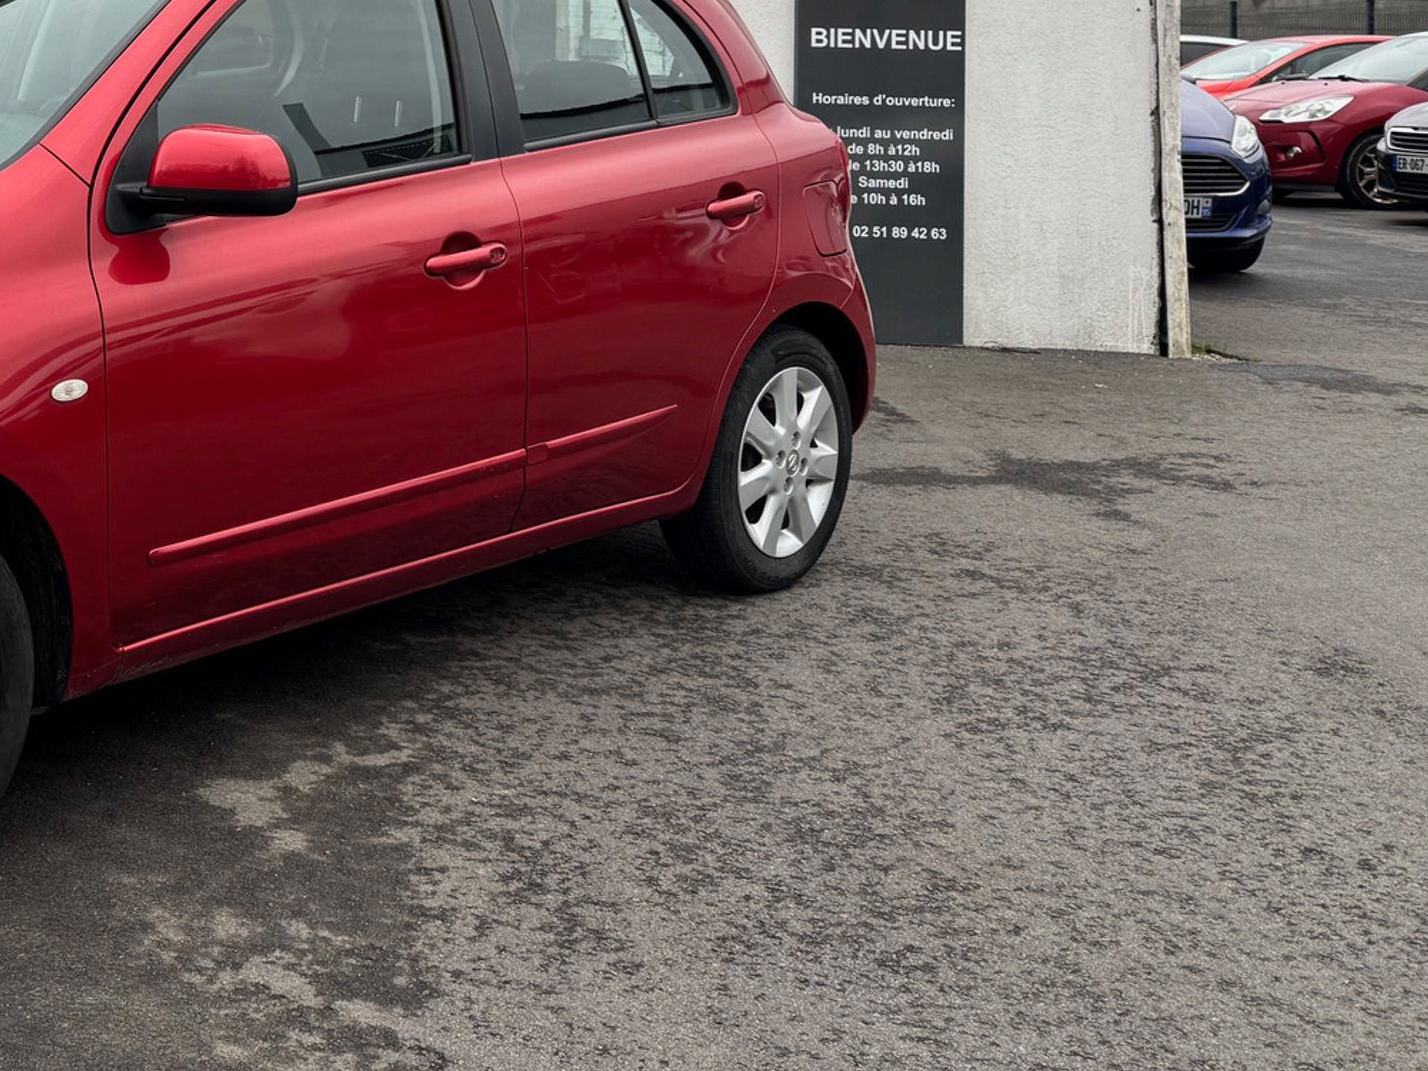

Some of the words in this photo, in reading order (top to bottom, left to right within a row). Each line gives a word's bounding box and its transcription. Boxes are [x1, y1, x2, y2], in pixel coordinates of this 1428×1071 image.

[810, 27, 963, 51] BIENVENUE
[812, 92, 870, 106] Horaires
[873, 94, 955, 108] d'ouverture:
[837, 126, 871, 139] lundi
[874, 129, 891, 139] au
[894, 128, 954, 141] vendredi
[847, 142, 864, 155] de
[867, 142, 884, 155] 8h
[864, 159, 904, 172] 13h30
[858, 175, 909, 189] Samedi
[861, 192, 886, 205] 10h
[889, 192, 898, 206] à
[901, 193, 926, 206] 16h
[852, 225, 869, 238] 02
[872, 225, 887, 238] 51
[891, 226, 908, 239] 89
[910, 227, 928, 240] 42
[930, 227, 947, 240] 63
